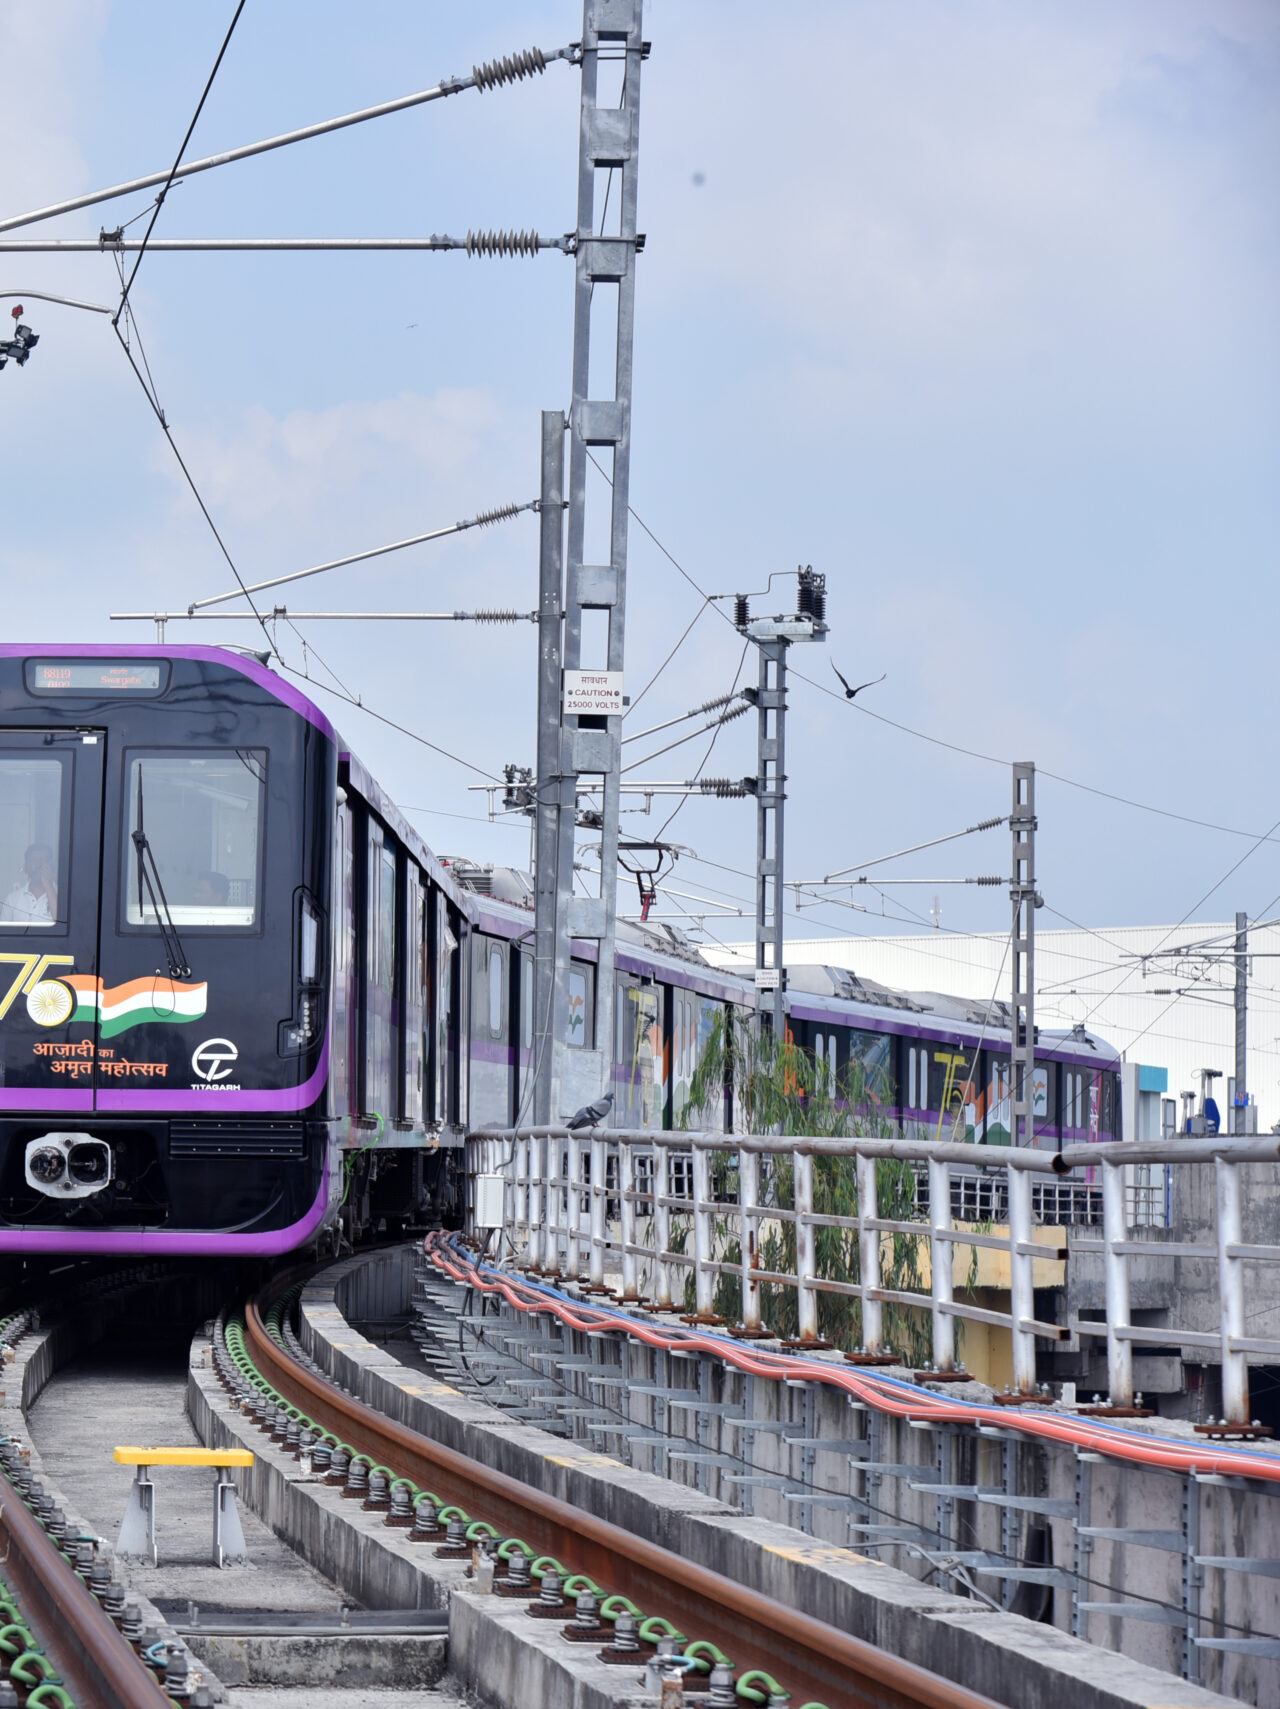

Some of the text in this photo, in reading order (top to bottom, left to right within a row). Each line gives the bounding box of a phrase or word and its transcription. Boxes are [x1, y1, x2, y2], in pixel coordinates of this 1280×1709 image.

[575, 689, 613, 697] CAUTION
[98, 1049, 114, 1059] का
[50, 1057, 168, 1079] अमृत महोत्सव
